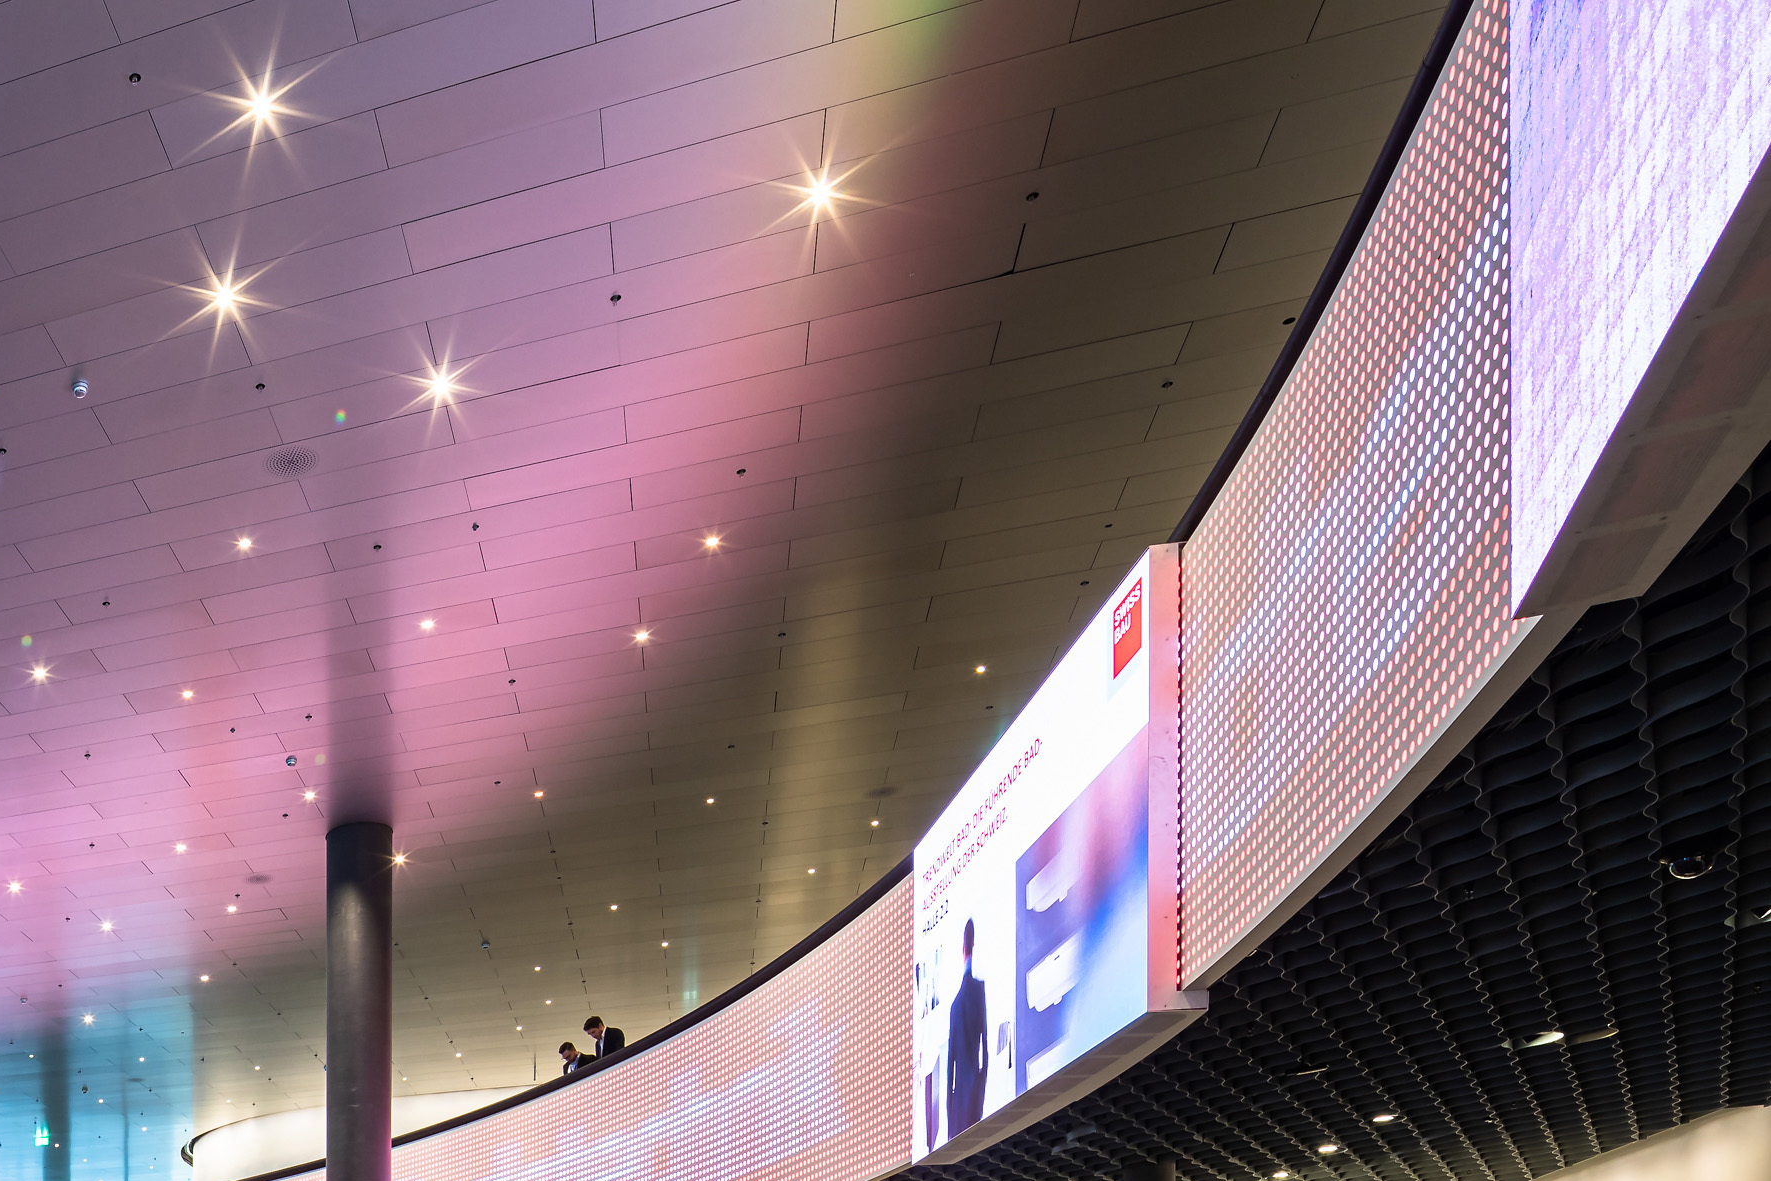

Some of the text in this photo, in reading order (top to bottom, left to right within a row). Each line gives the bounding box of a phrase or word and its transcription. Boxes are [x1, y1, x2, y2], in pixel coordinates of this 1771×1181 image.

[1114, 583, 1141, 628] SWISS
[1114, 611, 1132, 645] BAU
[922, 838, 956, 887] TRENDWELT
[973, 805, 984, 829] DIE
[985, 758, 1023, 814] FÜHRENDE
[922, 858, 961, 911] AUSSTELLUNG
[962, 843, 975, 868] DER
[922, 909, 939, 938] HALLE
